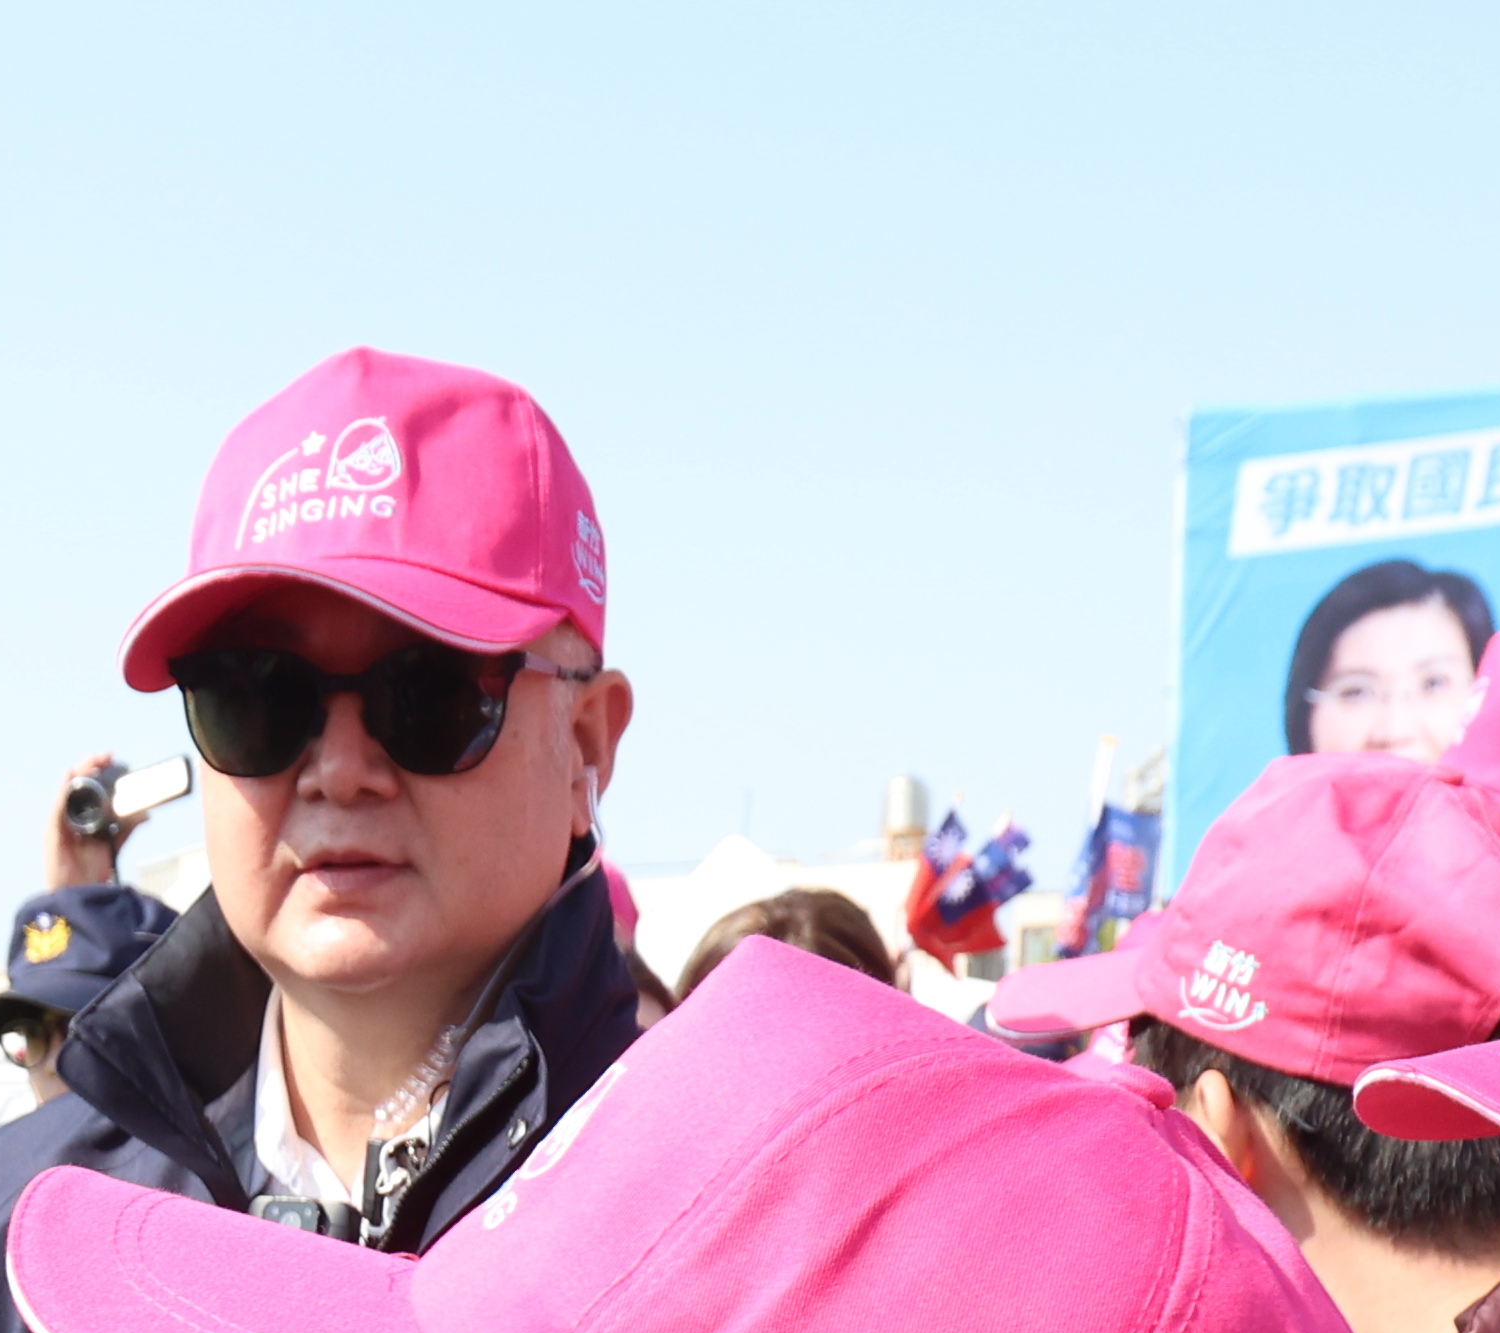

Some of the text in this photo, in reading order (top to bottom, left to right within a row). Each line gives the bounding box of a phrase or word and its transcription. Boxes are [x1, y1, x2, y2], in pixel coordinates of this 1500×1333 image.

[259, 467, 321, 510] SHE
[251, 492, 397, 544] SINGING
[1189, 968, 1252, 1020] WIN
